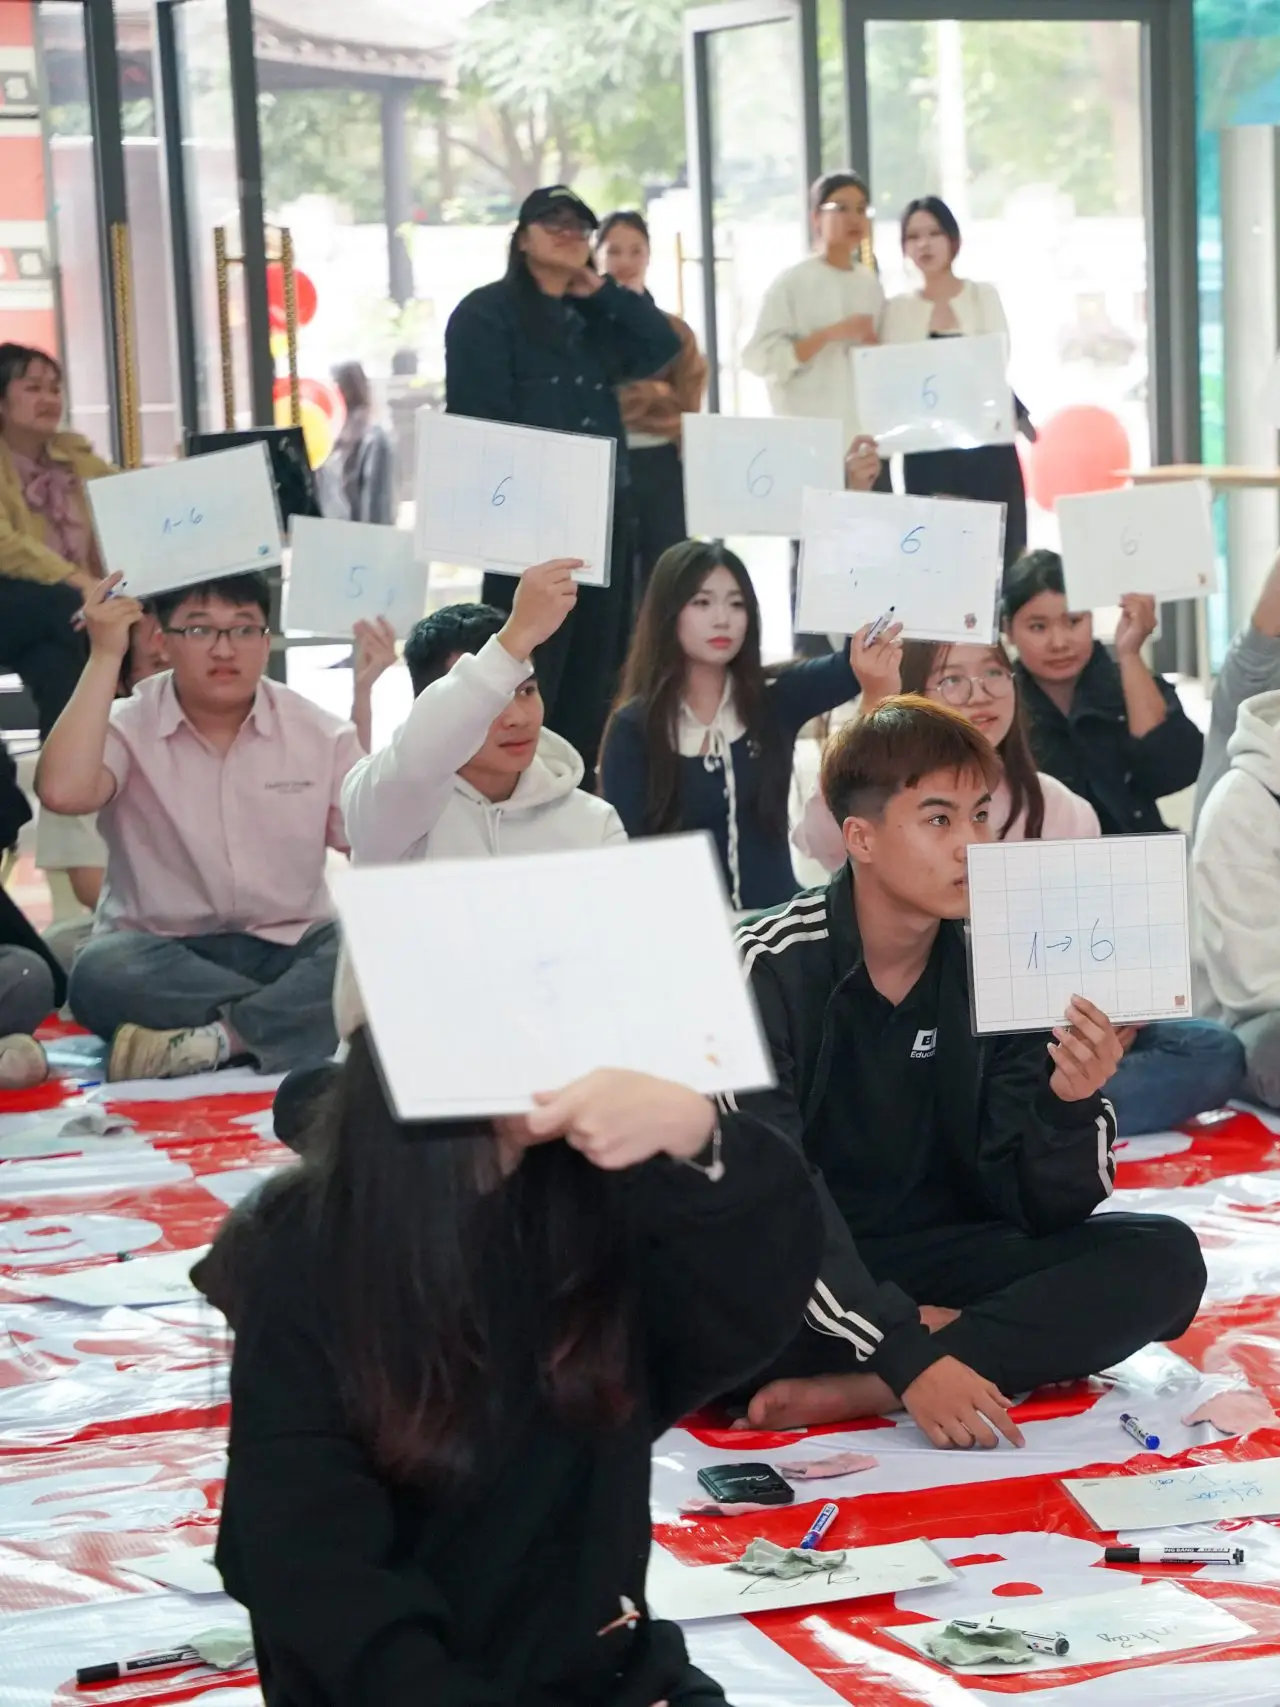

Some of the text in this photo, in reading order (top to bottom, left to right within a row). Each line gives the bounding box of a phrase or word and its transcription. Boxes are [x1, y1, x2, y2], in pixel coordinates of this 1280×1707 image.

[921, 373, 939, 410] 6
[744, 446, 775, 500] 6
[491, 476, 513, 507] 6
[900, 525, 926, 555] 6
[345, 565, 371, 600] 5
[1027, 917, 1115, 970] 1 6
